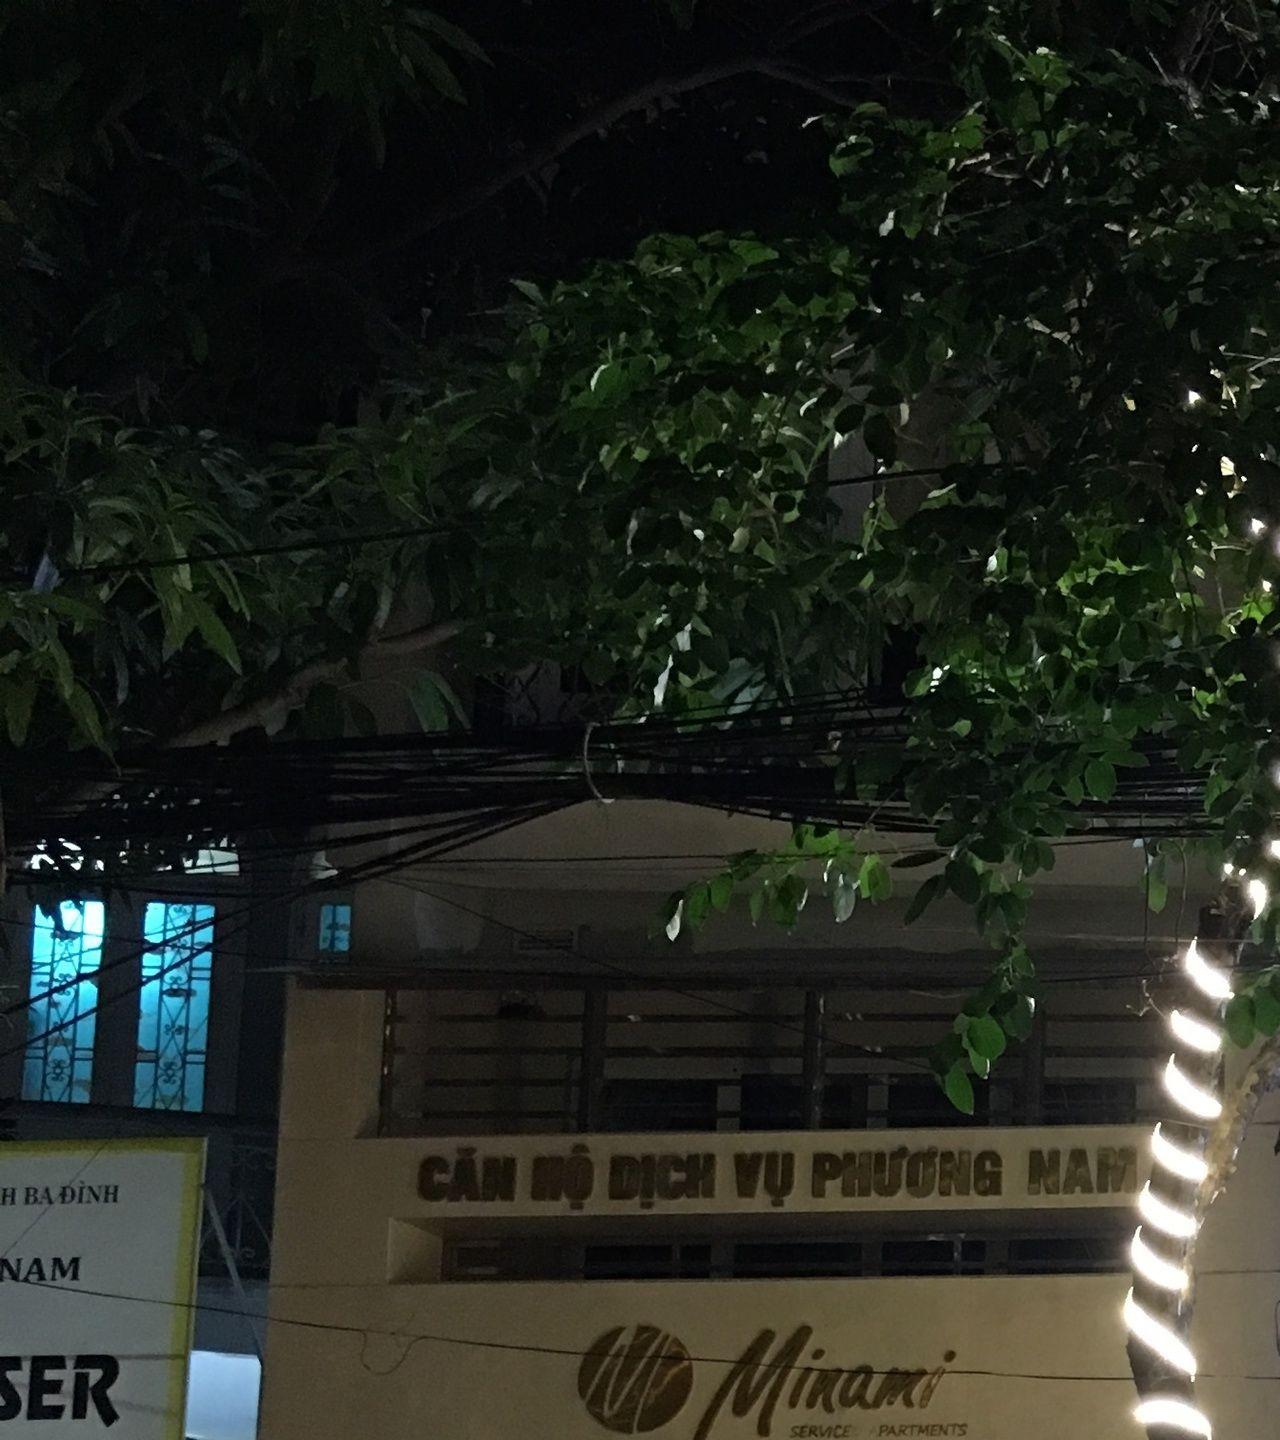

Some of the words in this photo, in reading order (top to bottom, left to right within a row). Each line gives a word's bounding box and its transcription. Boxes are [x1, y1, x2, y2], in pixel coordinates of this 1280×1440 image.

[607, 1152, 717, 1210] DỊCH
[733, 1151, 795, 1207] VỤ
[1026, 1147, 1138, 1195] NAM
